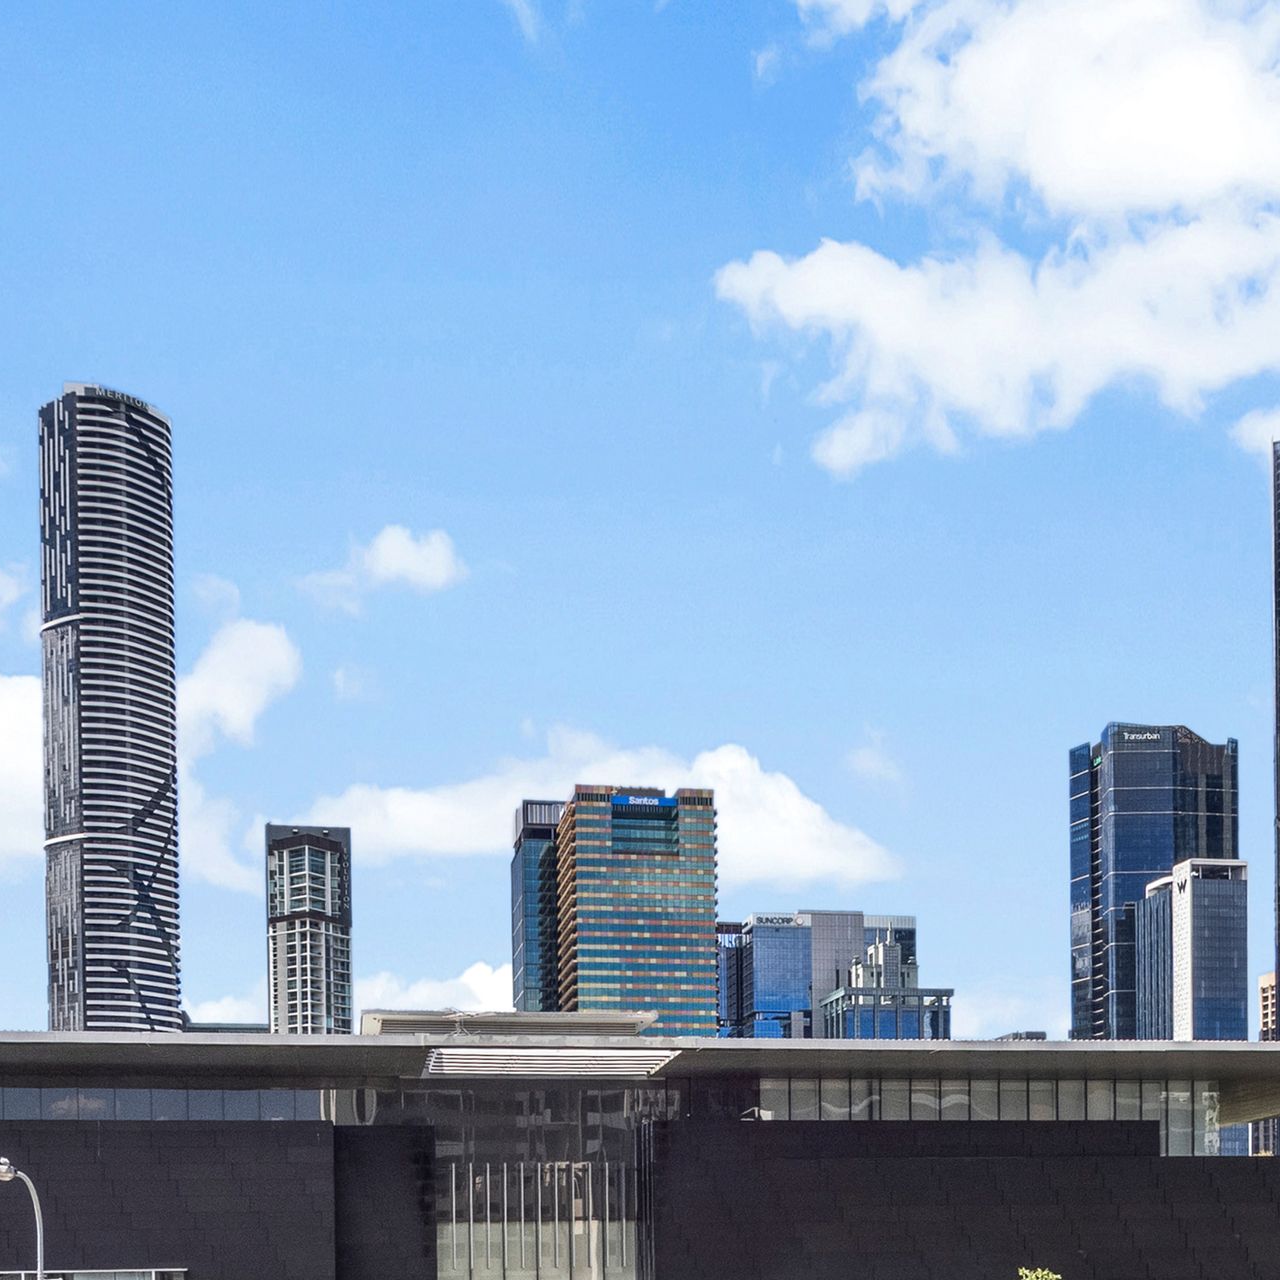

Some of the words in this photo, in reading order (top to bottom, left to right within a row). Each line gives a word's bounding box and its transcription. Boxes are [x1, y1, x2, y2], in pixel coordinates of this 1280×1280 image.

[95, 387, 151, 410] MERITON
[1122, 732, 1161, 740] Transurban
[629, 796, 659, 805] Santos
[1177, 879, 1187, 894] W
[756, 916, 793, 924] SUNCORP
